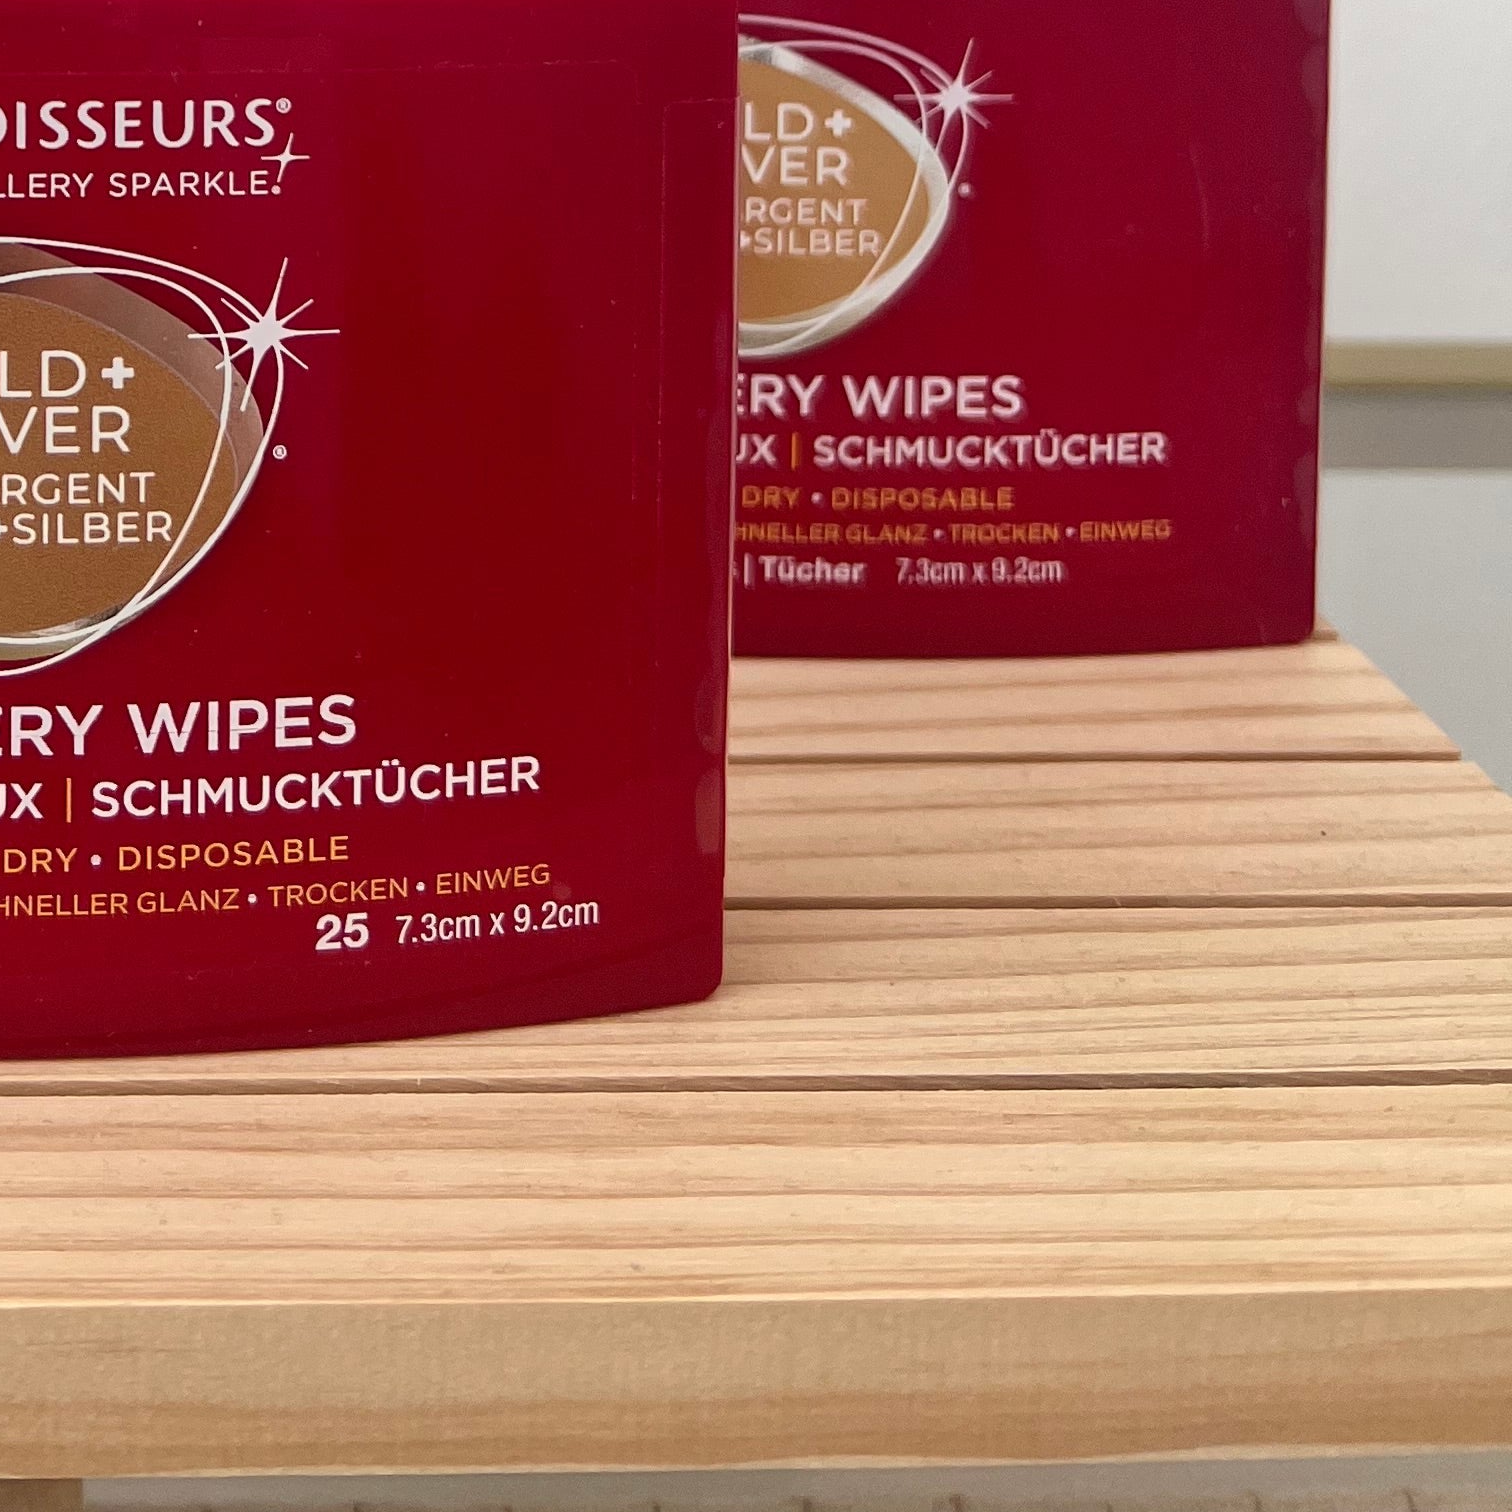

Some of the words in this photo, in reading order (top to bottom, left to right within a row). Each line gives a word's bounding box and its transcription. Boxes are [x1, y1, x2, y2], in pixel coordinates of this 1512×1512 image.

[843, 375, 1023, 418] WIPES
[814, 429, 1166, 467] SCHMUCKTÜCHER
[742, 486, 799, 508] DRY
[832, 488, 1014, 510] DISPOSABLE
[846, 524, 927, 545] GLANZ
[951, 524, 1060, 543] TROCKEN
[1080, 519, 1171, 541] EINWEG
[759, 556, 865, 583] Tücher
[897, 558, 966, 584] 7.3cm
[972, 563, 987, 583] x
[992, 557, 1063, 583] 9.2cm
[127, 694, 356, 753] WIPES
[92, 755, 539, 817] SCHMUCKTÜCHER
[4, 848, 77, 873] DRY
[119, 836, 348, 870] DISPOSABLE
[137, 889, 239, 913] GLANZ
[268, 877, 407, 907] TROCKEN
[437, 864, 549, 894] EINWEG
[316, 912, 369, 950] 25
[396, 913, 480, 944] 7.3cm
[490, 912, 504, 935] x
[514, 901, 599, 932] 9.2cm
